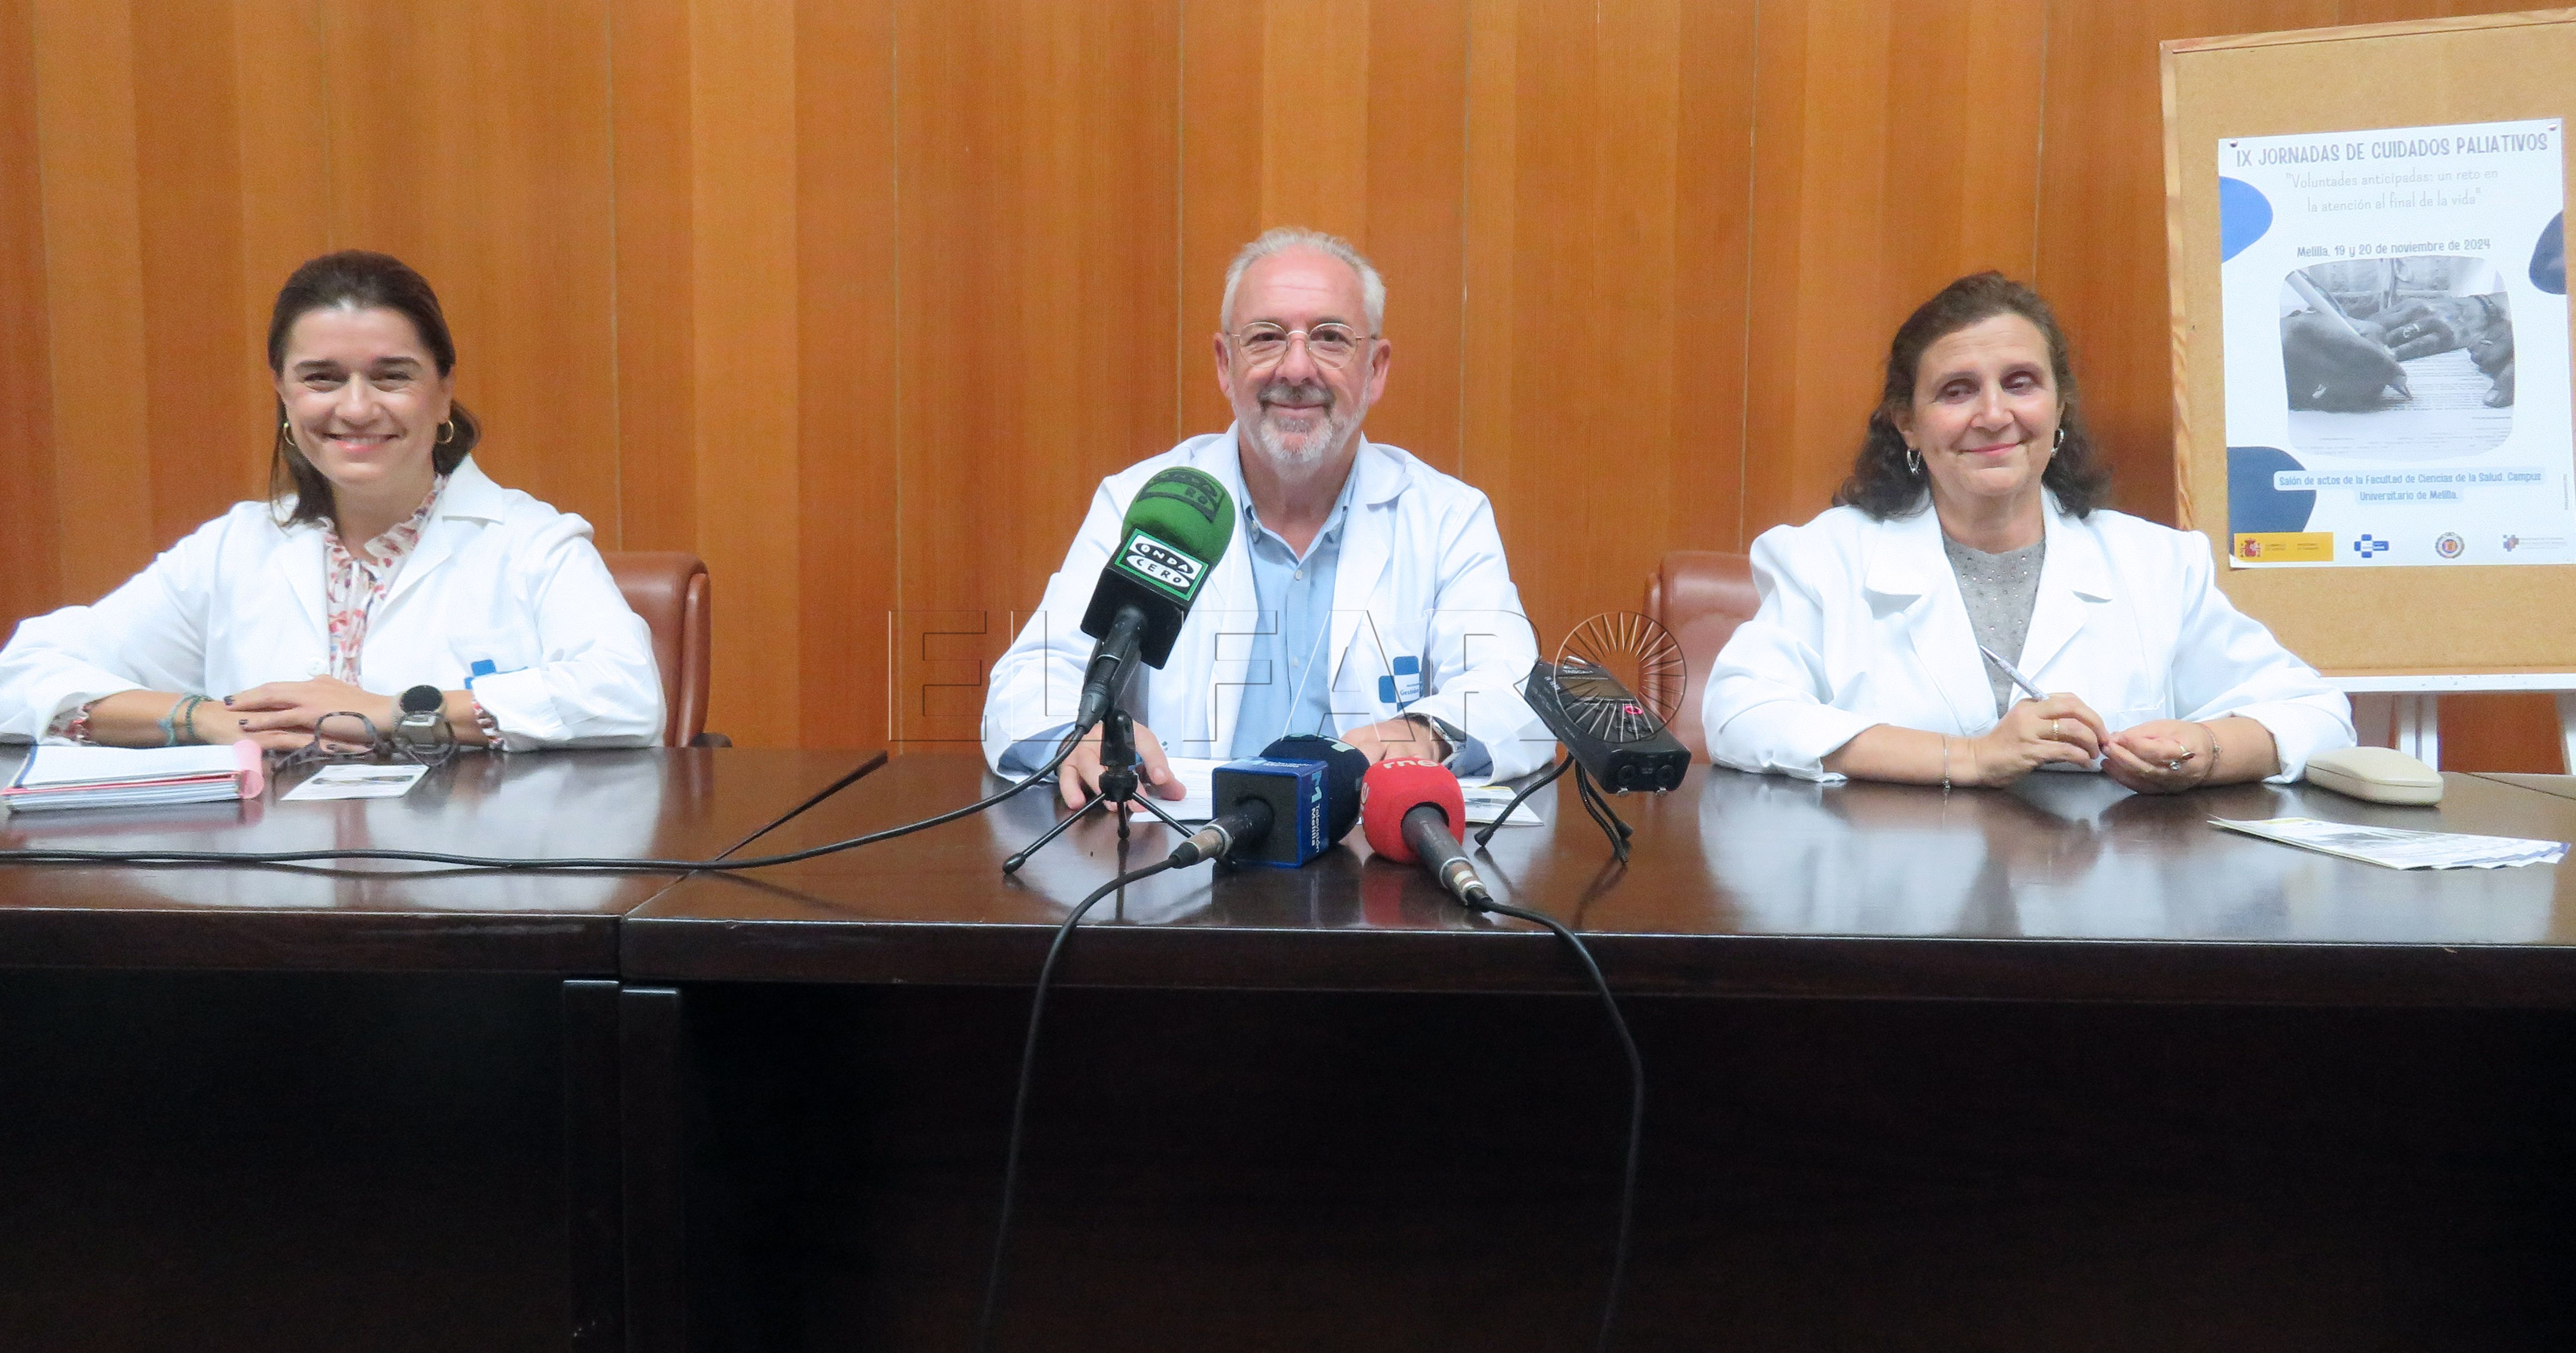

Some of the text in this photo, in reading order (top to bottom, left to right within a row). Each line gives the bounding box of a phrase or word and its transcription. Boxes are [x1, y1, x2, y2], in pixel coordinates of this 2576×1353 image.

[2237, 133, 2548, 167] IX JORNADAS DE CUIDADOS PALIATIVOS
[2286, 167, 2498, 188] "Voluntades anticipadas: un reto en
[2308, 187, 2481, 212] la atención al final de la vida"
[2335, 246, 2345, 255] 19
[2349, 247, 2355, 257] y
[2359, 244, 2372, 254] 20
[2375, 244, 2388, 254] de
[2391, 242, 2444, 253] noviembre
[2448, 241, 2460, 251] de
[2464, 239, 2491, 250] 2024
[2279, 476, 2302, 486] Salón
[2304, 476, 2314, 485] de
[2343, 476, 2353, 484] de
[2356, 475, 2363, 484] la
[2366, 475, 2403, 484] Facultad
[2405, 475, 2415, 483] de
[2418, 474, 2453, 483] Ciencias
[2455, 473, 2466, 482] de
[2469, 473, 2476, 482] la
[2507, 472, 2541, 482] Campus
[2359, 491, 2414, 501] Universitario
[2416, 491, 2427, 499] de
[1140, 544, 1188, 572] ONDA
[1136, 559, 1182, 583] CERO
[1383, 760, 1439, 769] rne
